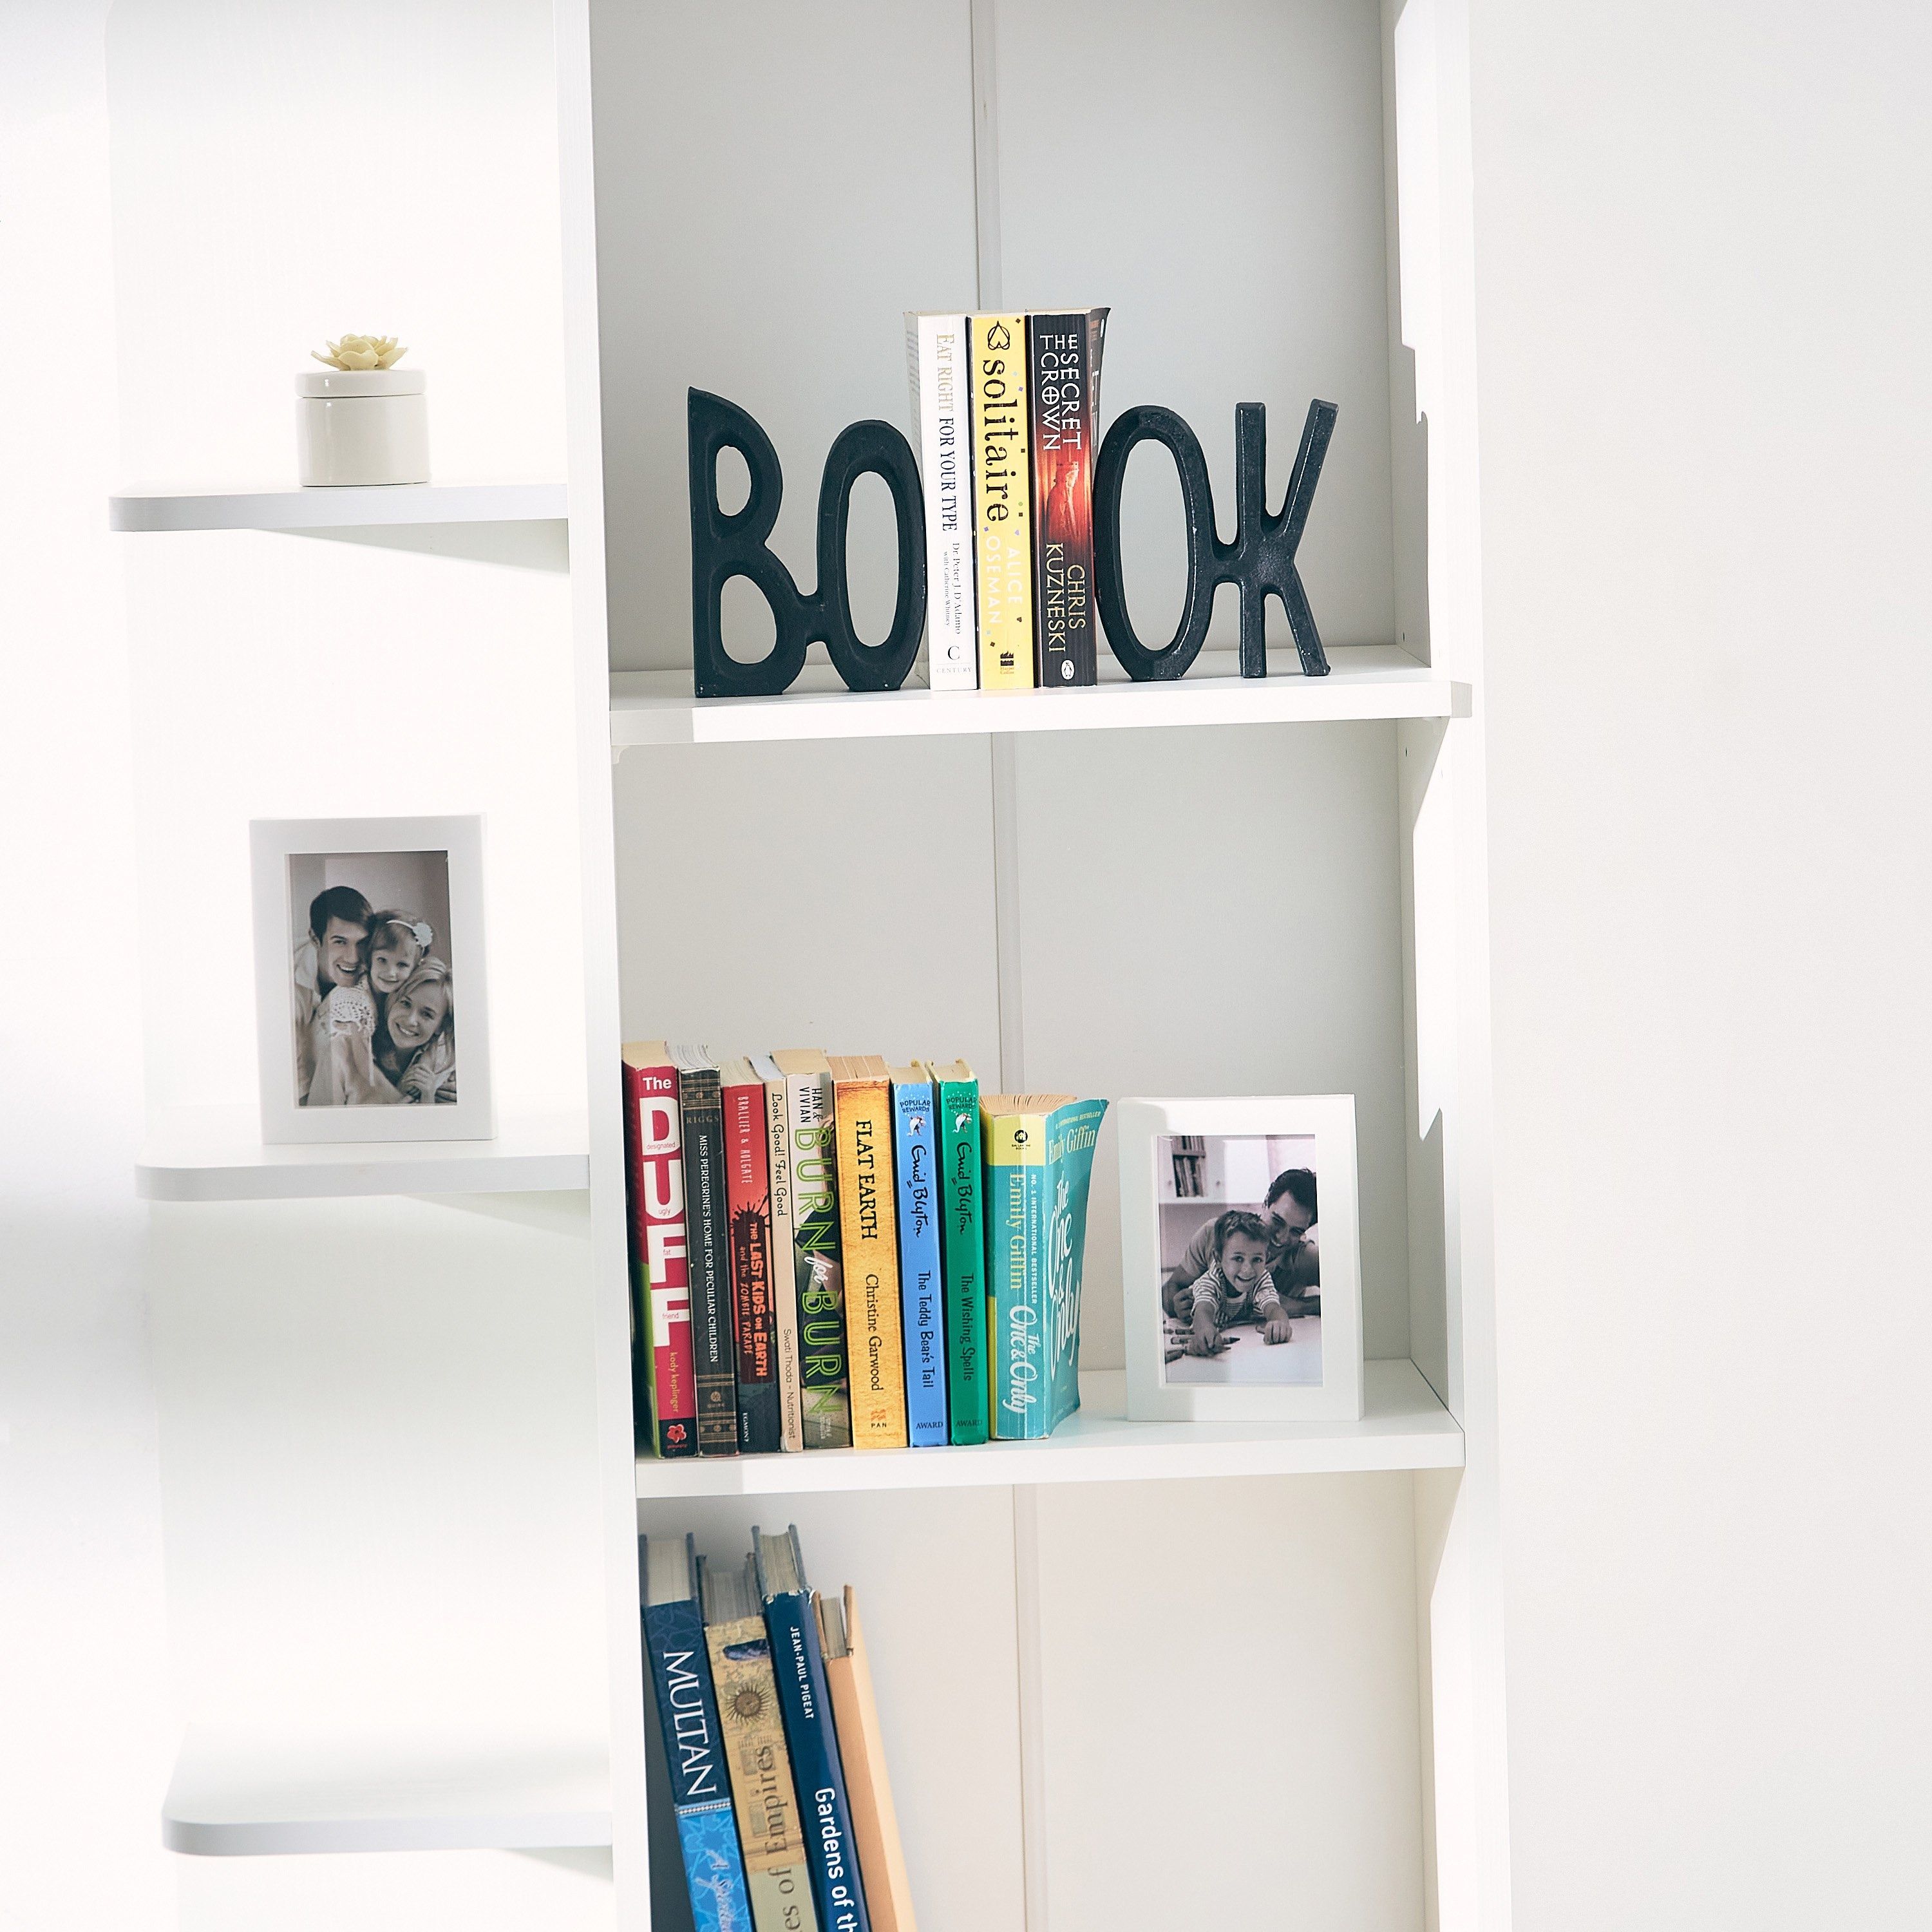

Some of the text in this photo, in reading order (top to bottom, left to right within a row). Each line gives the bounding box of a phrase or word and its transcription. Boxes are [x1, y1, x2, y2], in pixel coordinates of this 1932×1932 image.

[1039, 334, 1078, 350] THE
[1040, 352, 1061, 450] CROWN
[1060, 352, 1081, 450] SECRET
[936, 334, 957, 531] EAT RIGHT FOR YOUR TYPE
[983, 359, 1019, 522] solitaire
[986, 535, 1003, 623] OSEMAN
[1007, 547, 1022, 604] ALICE
[1045, 542, 1065, 652] KUZNESKI
[1067, 564, 1086, 629] CHRIS
[947, 645, 960, 660] C
[643, 1077, 672, 1090] The
[799, 1086, 811, 1123] VIVIAN
[812, 1088, 823, 1109] HAN
[900, 1099, 931, 1108] POPULAR
[946, 1097, 978, 1105] POPULAR
[686, 1115, 719, 1124] RIGGS
[737, 1096, 750, 1133] BRALLIER
[646, 1142, 676, 1150] designated
[741, 1150, 752, 1184] HOLGATE
[771, 1093, 788, 1217] Look Good! Feel Good
[1048, 1125, 1096, 1165] Emily Giffin
[795, 1127, 836, 1251] BURN
[857, 1119, 878, 1239] FLAT EARTH
[911, 1186, 929, 1238] Blyton
[955, 1184, 973, 1235] Blyton
[1005, 1173, 1027, 1290] Emily Giffin
[699, 1135, 718, 1362] MISS PEREGRINE'S HOME FOR PECULIAR CHILDREN
[750, 1243, 762, 1278] LAST
[804, 1256, 833, 1284] for
[752, 1281, 766, 1315] KIDS
[783, 1329, 792, 1354] Swati
[866, 1274, 885, 1391] Christine Garwood
[918, 1270, 934, 1388] The Teddy Bear's Tail
[959, 1273, 976, 1381] The Wishing Spells
[1009, 1305, 1038, 1346] One
[1027, 1332, 1041, 1354] The
[753, 1332, 768, 1377] EARTH
[784, 1355, 793, 1383] Thoda
[802, 1291, 842, 1414] BURN
[668, 1352, 679, 1412] kody keplinger
[1002, 1361, 1038, 1414] Only
[786, 1392, 796, 1439] Nutritionist
[916, 1421, 943, 1430] AWARD
[790, 1627, 813, 1719] JEAN-PAUL PIGEAT
[663, 1651, 717, 1795] MULTAN
[755, 1745, 788, 1855] Empires
[815, 1788, 844, 1880] Gardens
[831, 1886, 855, 1907] of
[768, 1868, 795, 1894] of
